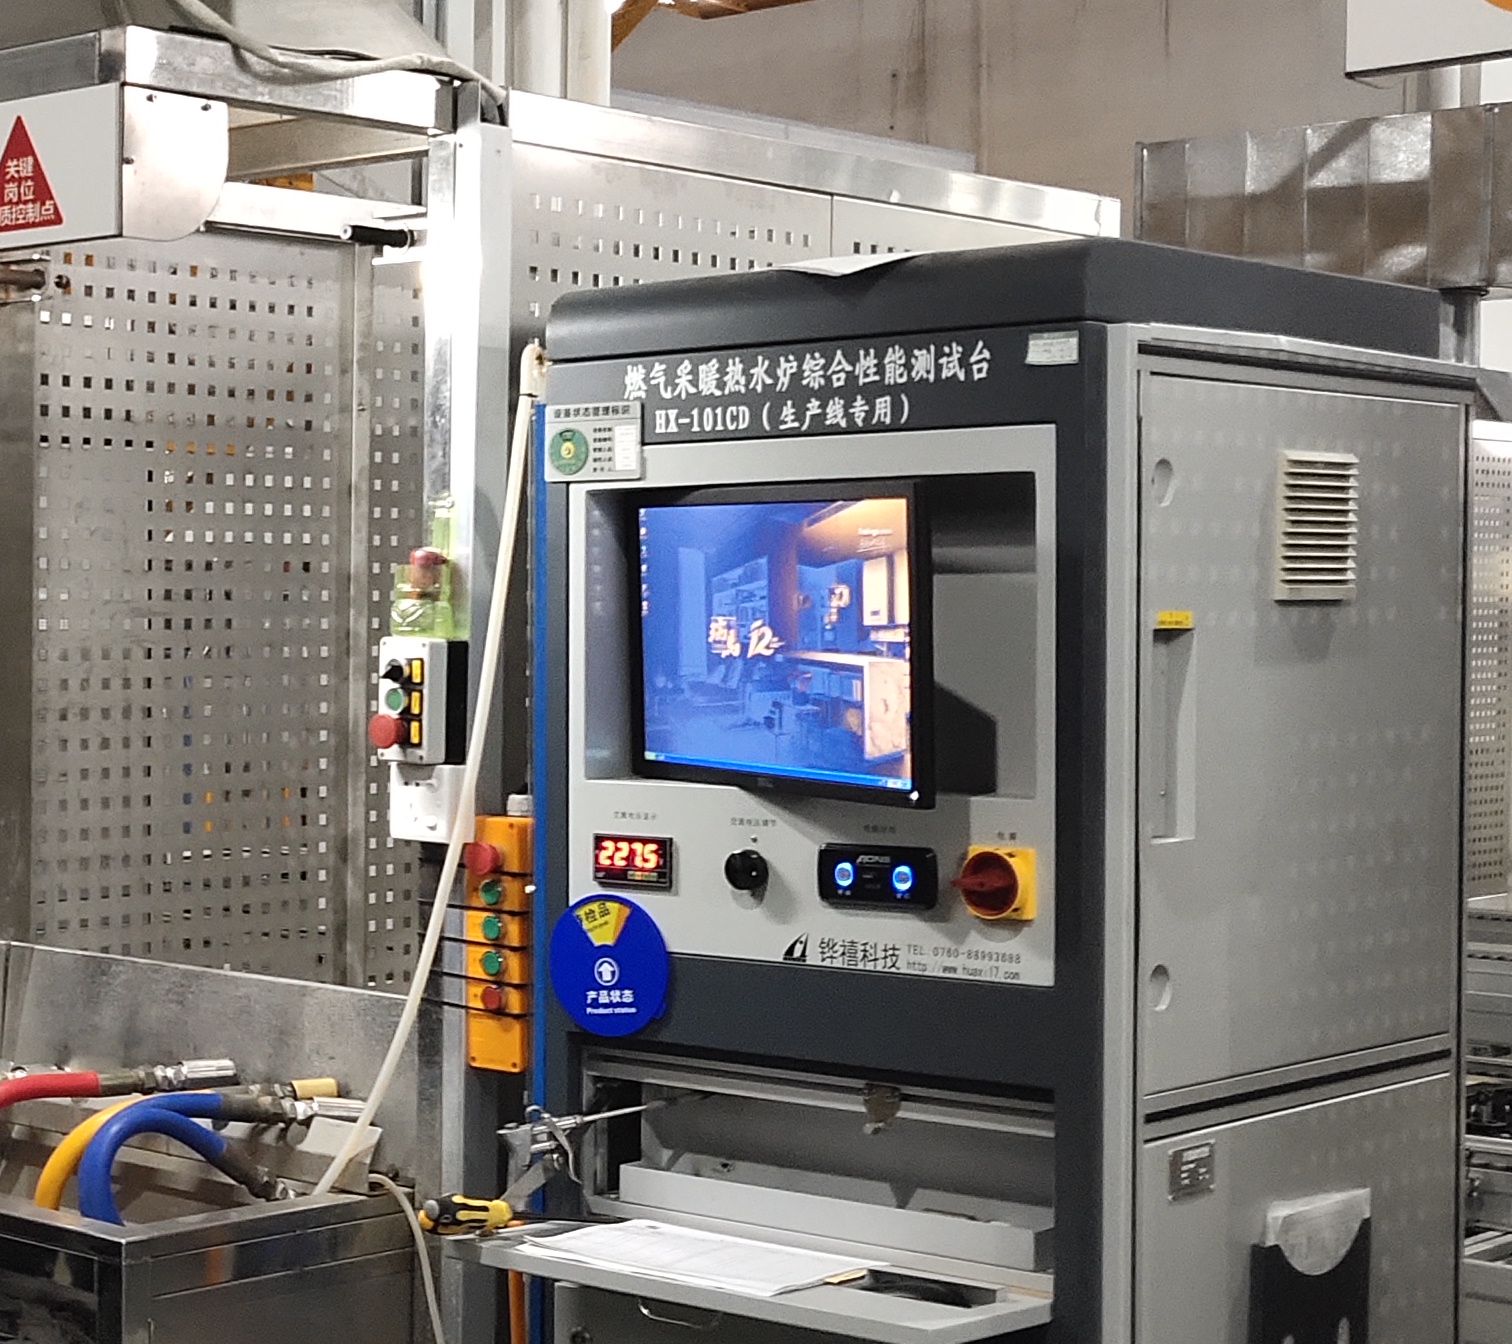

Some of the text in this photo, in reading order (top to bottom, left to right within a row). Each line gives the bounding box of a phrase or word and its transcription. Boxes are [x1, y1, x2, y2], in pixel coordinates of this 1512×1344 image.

[4, 156, 35, 180] 关键
[4, 179, 35, 204] 岗位
[623, 340, 992, 400] 燃气采暖热水炉综合性能测试台
[818, 937, 901, 971] 铧禧科技
[586, 989, 635, 1004] 产品状态
